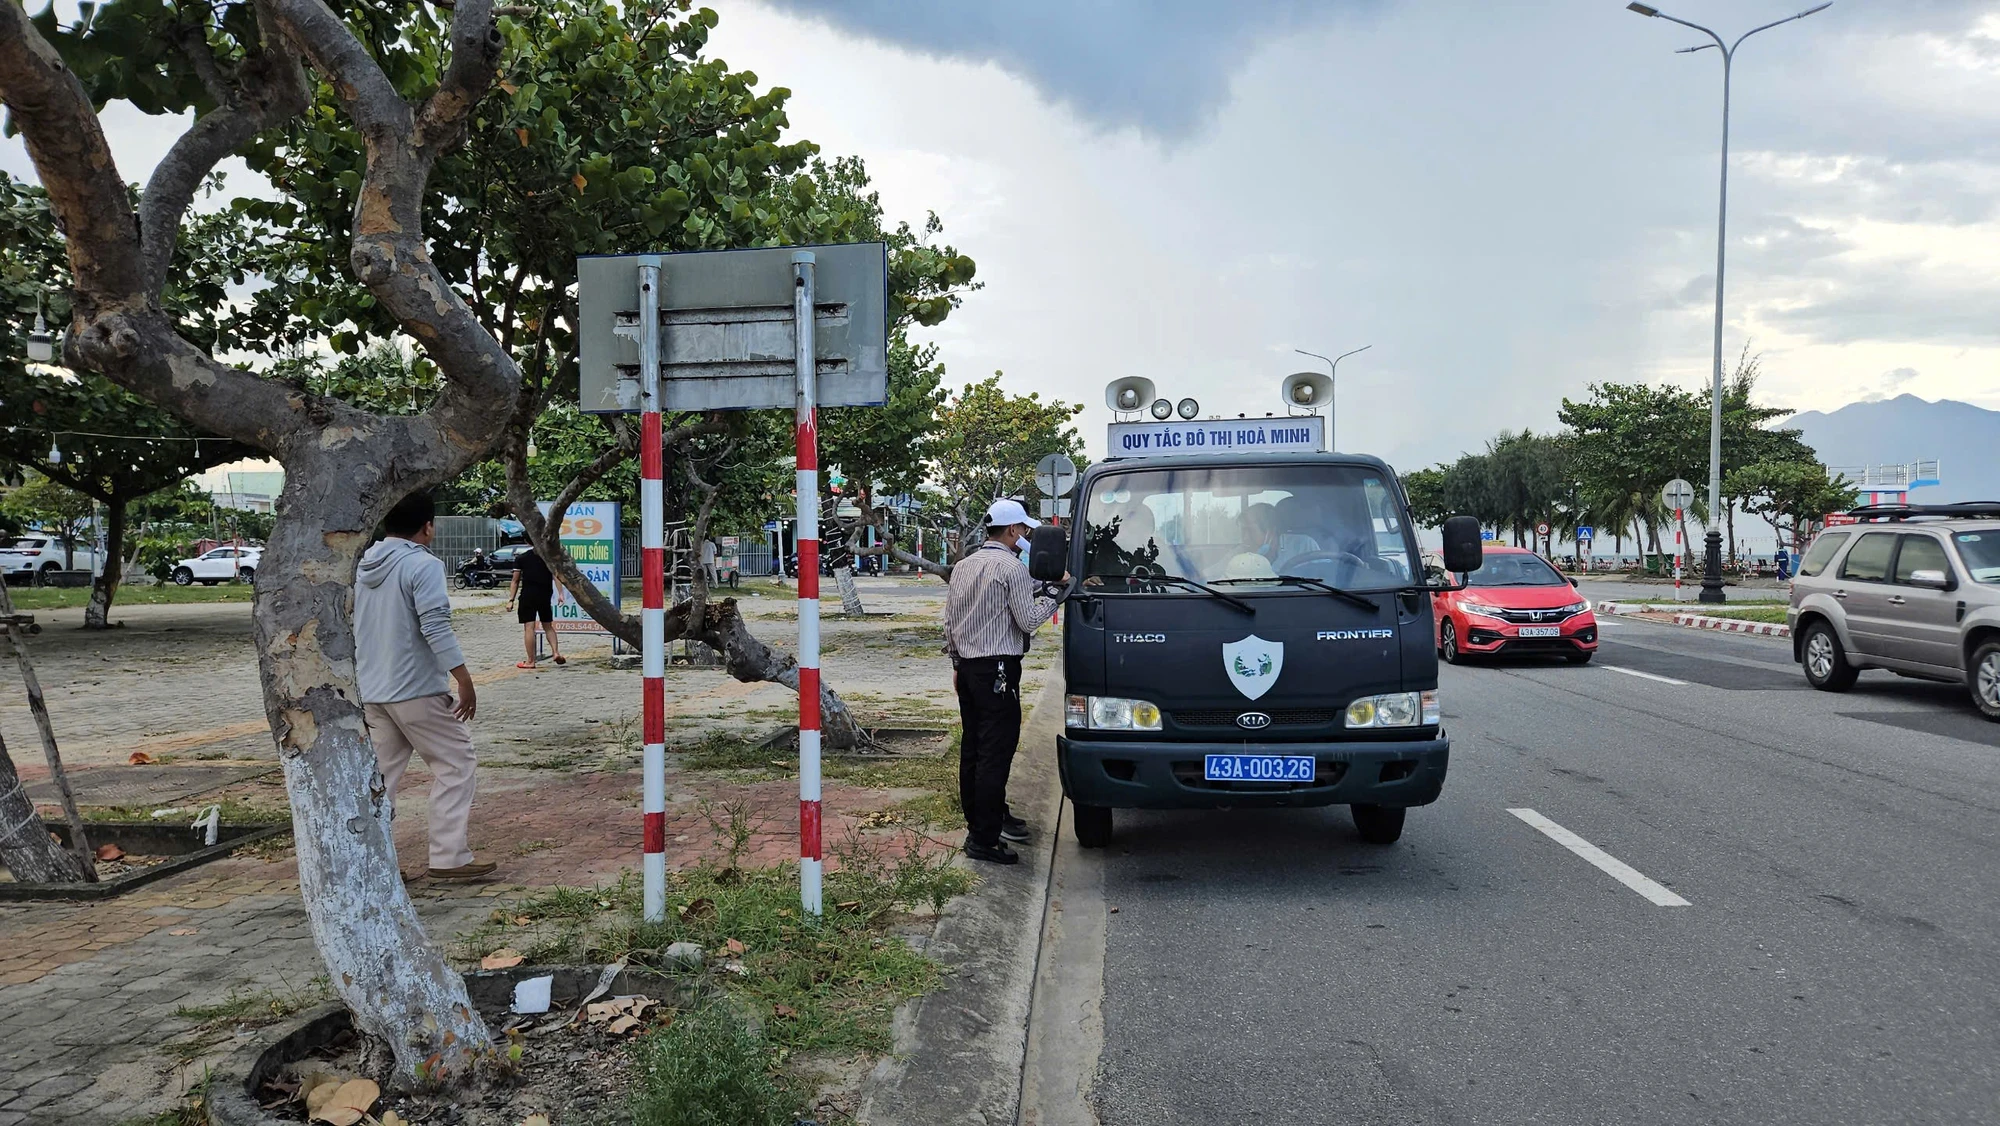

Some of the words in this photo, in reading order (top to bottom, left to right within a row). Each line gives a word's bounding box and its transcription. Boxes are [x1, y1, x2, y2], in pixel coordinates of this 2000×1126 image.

[1122, 433, 1150, 450] QUY
[1154, 428, 1181, 447] TẮC
[1186, 428, 1205, 446] ĐÔ
[1210, 430, 1232, 448] THỊ
[1237, 426, 1267, 445] HOÀ
[1271, 427, 1310, 444] MINH
[566, 504, 595, 516] UÁN
[589, 540, 609, 560] SỐNG
[562, 602, 578, 618] CÁ
[1113, 633, 1166, 644] THACO
[1316, 629, 1393, 641] FRONTIER
[1242, 716, 1265, 725] KIA
[1209, 758, 1311, 779] 43A-003.26
